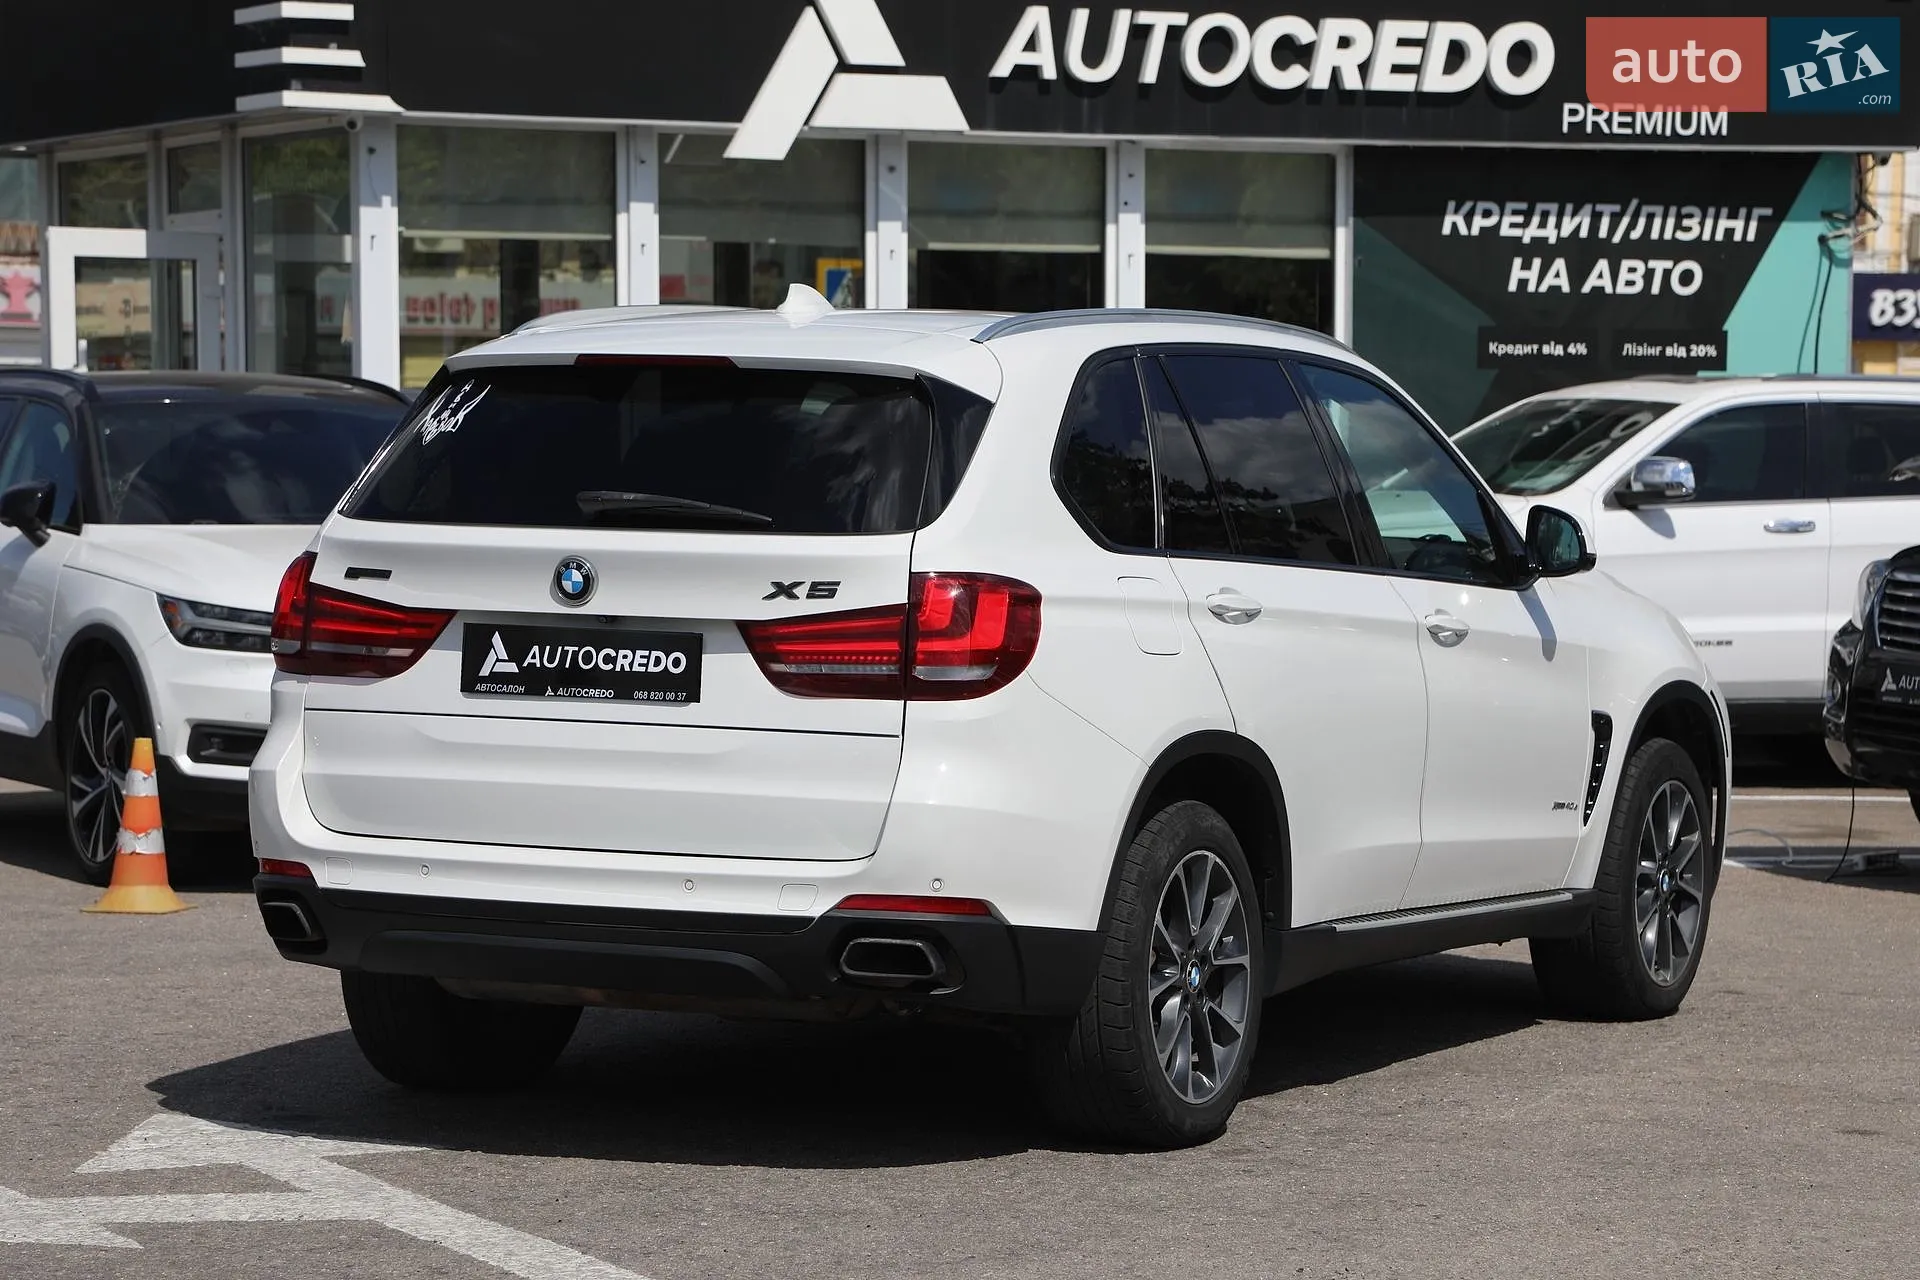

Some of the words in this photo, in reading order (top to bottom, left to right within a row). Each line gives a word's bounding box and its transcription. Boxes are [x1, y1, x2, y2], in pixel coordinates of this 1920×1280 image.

[988, 5, 1556, 96] AUTOCREDO
[1562, 102, 1728, 137] PREMIUM
[1441, 198, 1773, 244] КРЕДИТ/ЛІЗІНГ
[1507, 256, 1571, 294] НА
[1580, 257, 1703, 297] АВТО
[1489, 342, 1539, 356] Кредит
[1542, 341, 1564, 357] від
[1567, 343, 1588, 356] 4%
[1622, 343, 1663, 357] Лізінг
[1665, 343, 1687, 358] від
[1690, 344, 1718, 358] 20%
[560, 562, 589, 575] BMW
[761, 580, 842, 601] X5
[522, 645, 687, 674] AUTOCREDO
[474, 683, 525, 694] АВТОСАЛОН
[556, 687, 615, 699] AUTOCREDO
[633, 691, 648, 699] 068
[649, 692, 664, 700] 820
[665, 692, 675, 700] 00
[677, 692, 686, 700] 37
